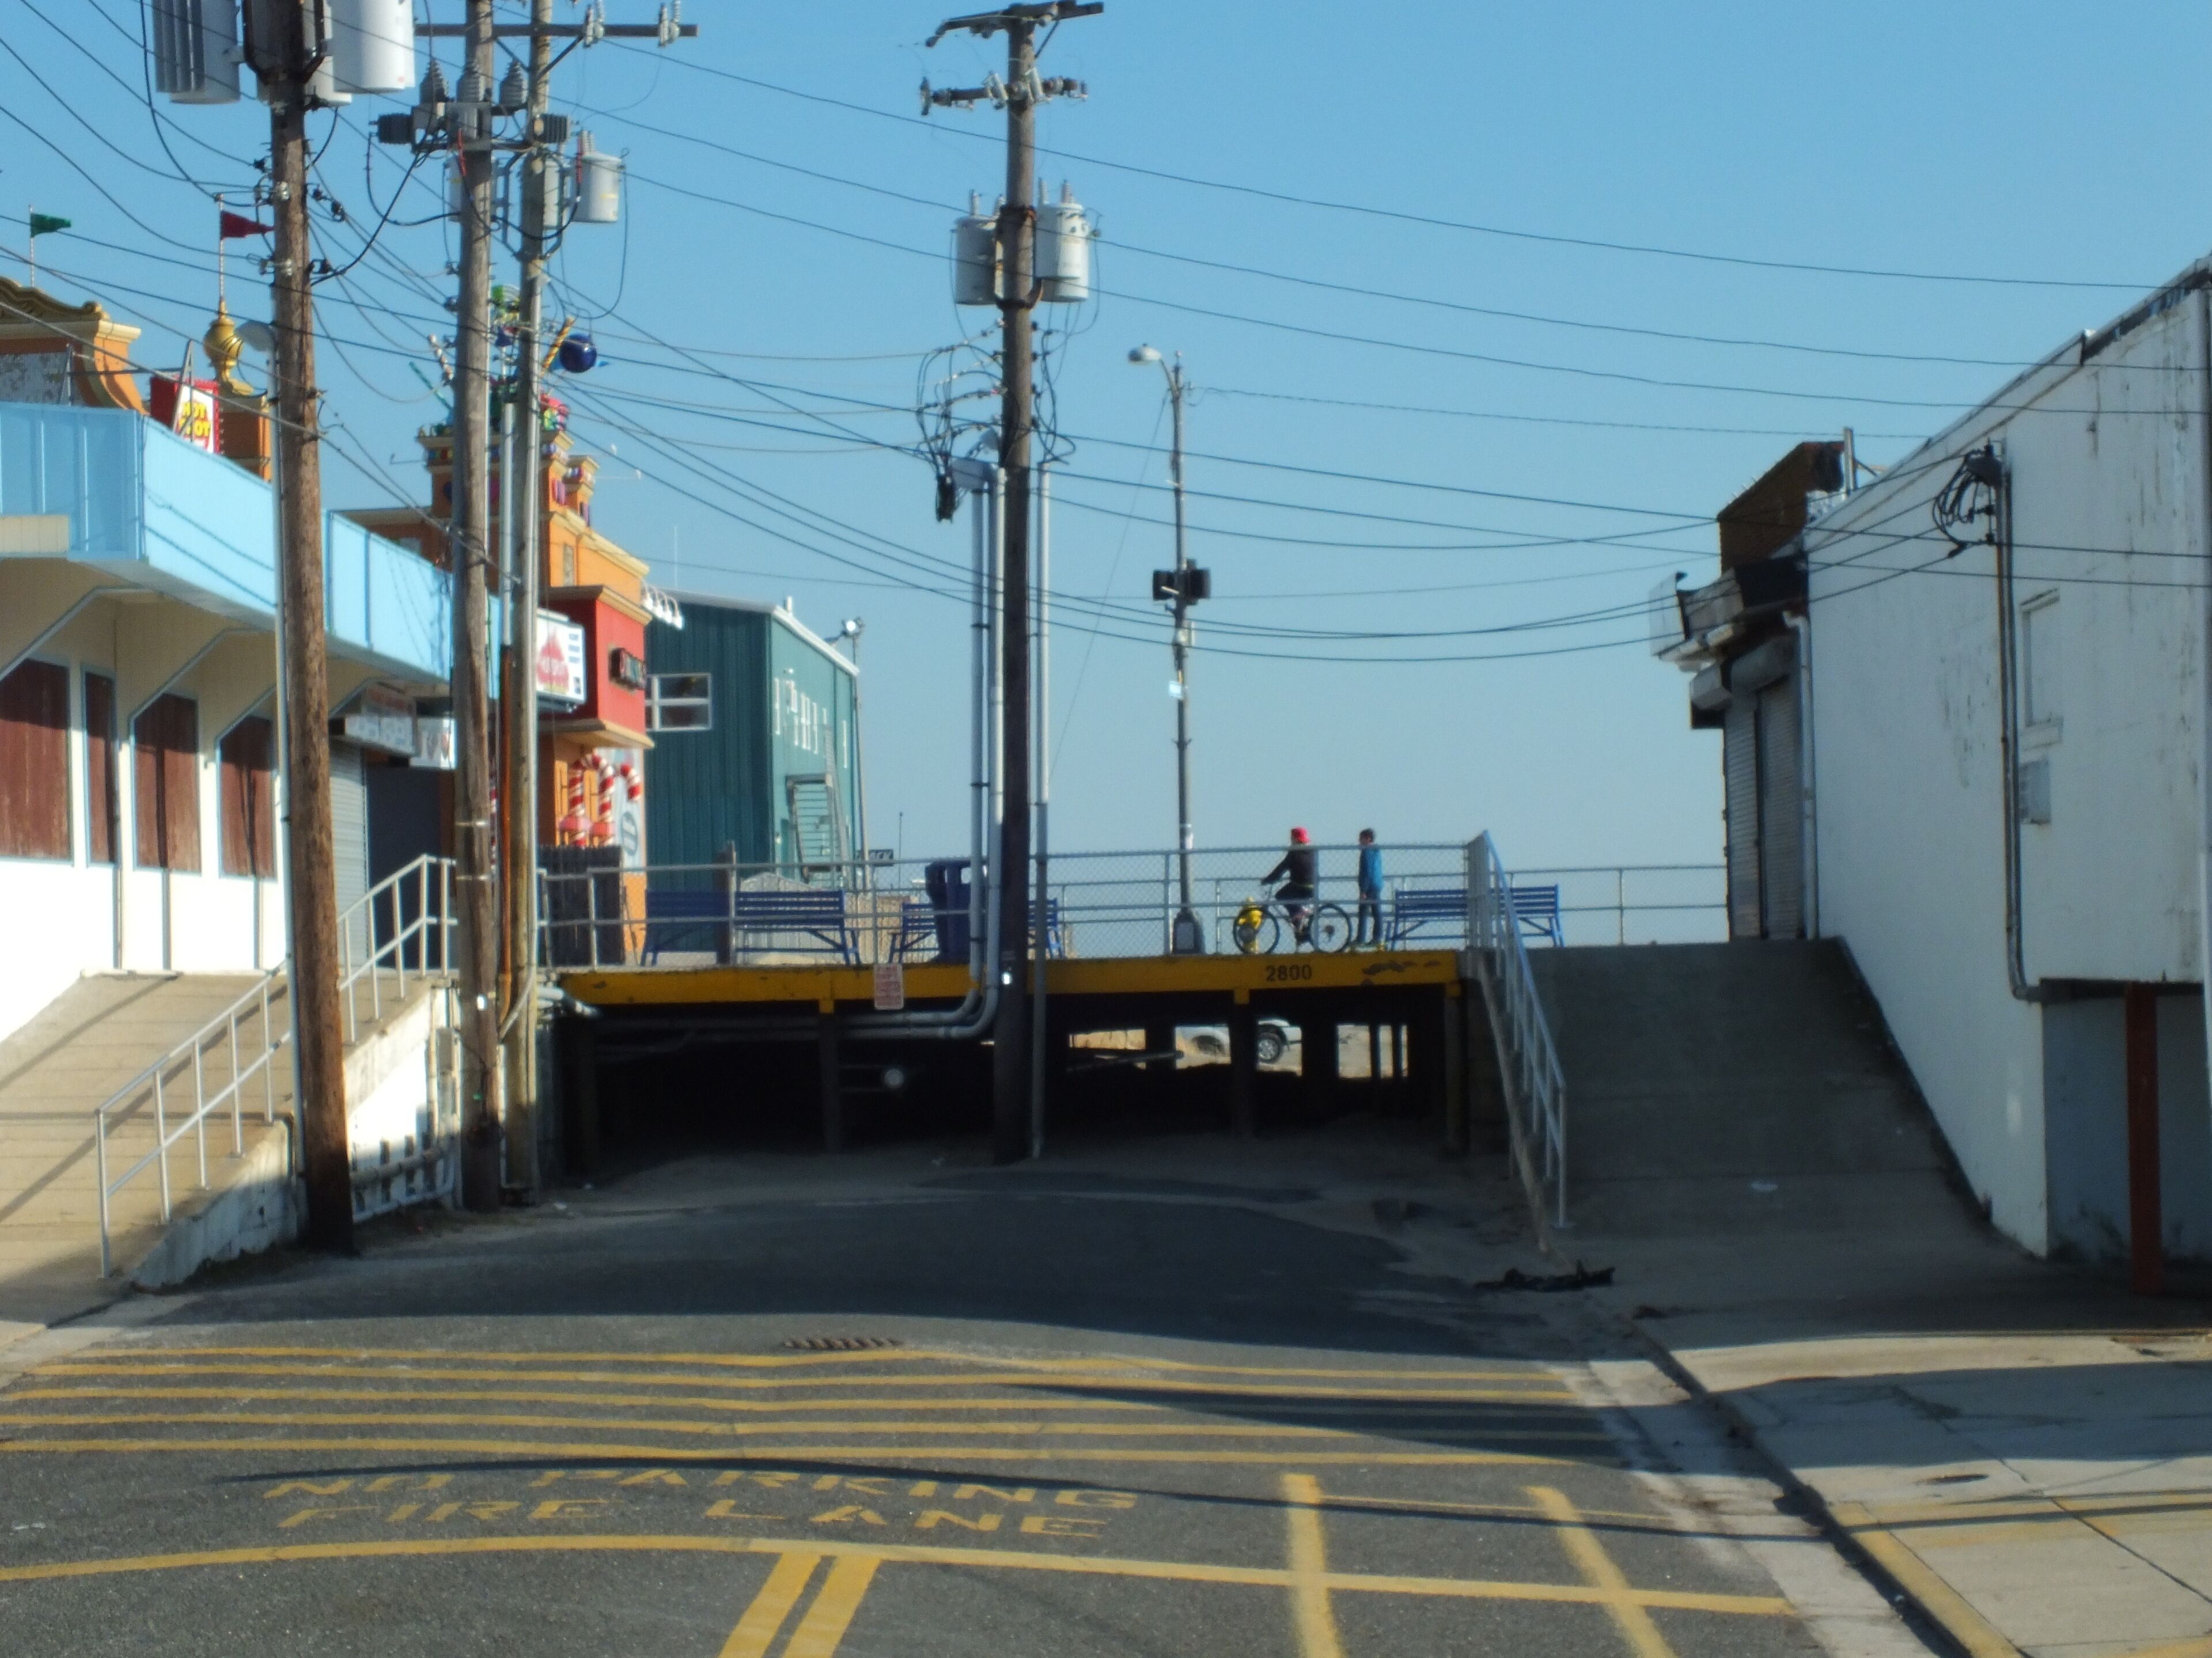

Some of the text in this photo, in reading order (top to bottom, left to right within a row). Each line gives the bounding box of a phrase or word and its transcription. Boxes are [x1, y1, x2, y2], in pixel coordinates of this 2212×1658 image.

[1266, 964, 1313, 981] 2800
[263, 1469, 1138, 1508] NO PARKING
[278, 1499, 1111, 1537] FIRE LANE
